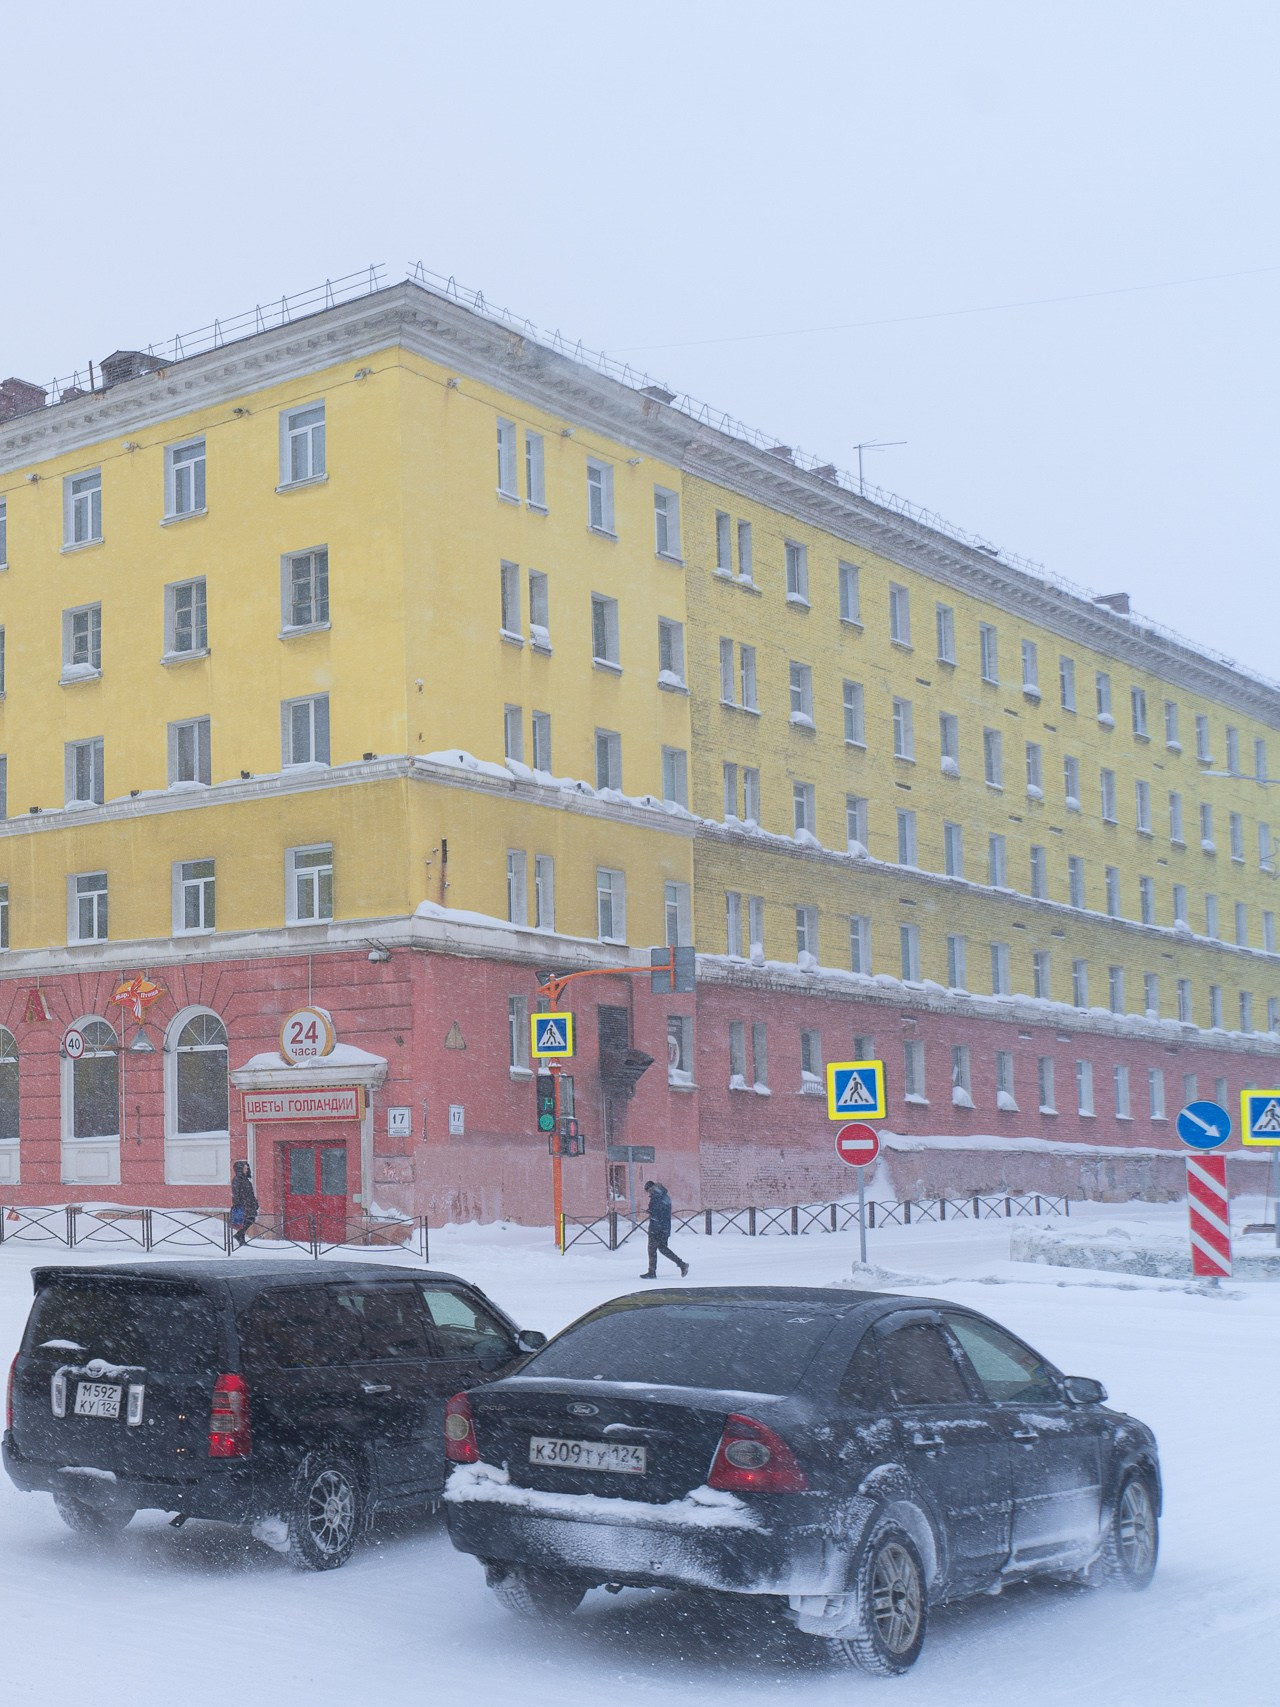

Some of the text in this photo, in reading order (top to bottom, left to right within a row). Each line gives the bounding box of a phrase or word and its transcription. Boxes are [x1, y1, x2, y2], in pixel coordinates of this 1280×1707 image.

[290, 1020, 319, 1045] 24
[68, 1038, 81, 1050] 40
[291, 1047, 317, 1056] часа
[247, 1097, 353, 1115] ЦВЕТЫ ГОЛЛАНДИИ
[392, 1113, 405, 1125] 17
[452, 1111, 462, 1122] 17
[83, 1384, 114, 1399] М592
[80, 1400, 96, 1413] КУ
[101, 1402, 117, 1412] 124
[611, 1446, 642, 1464] 124
